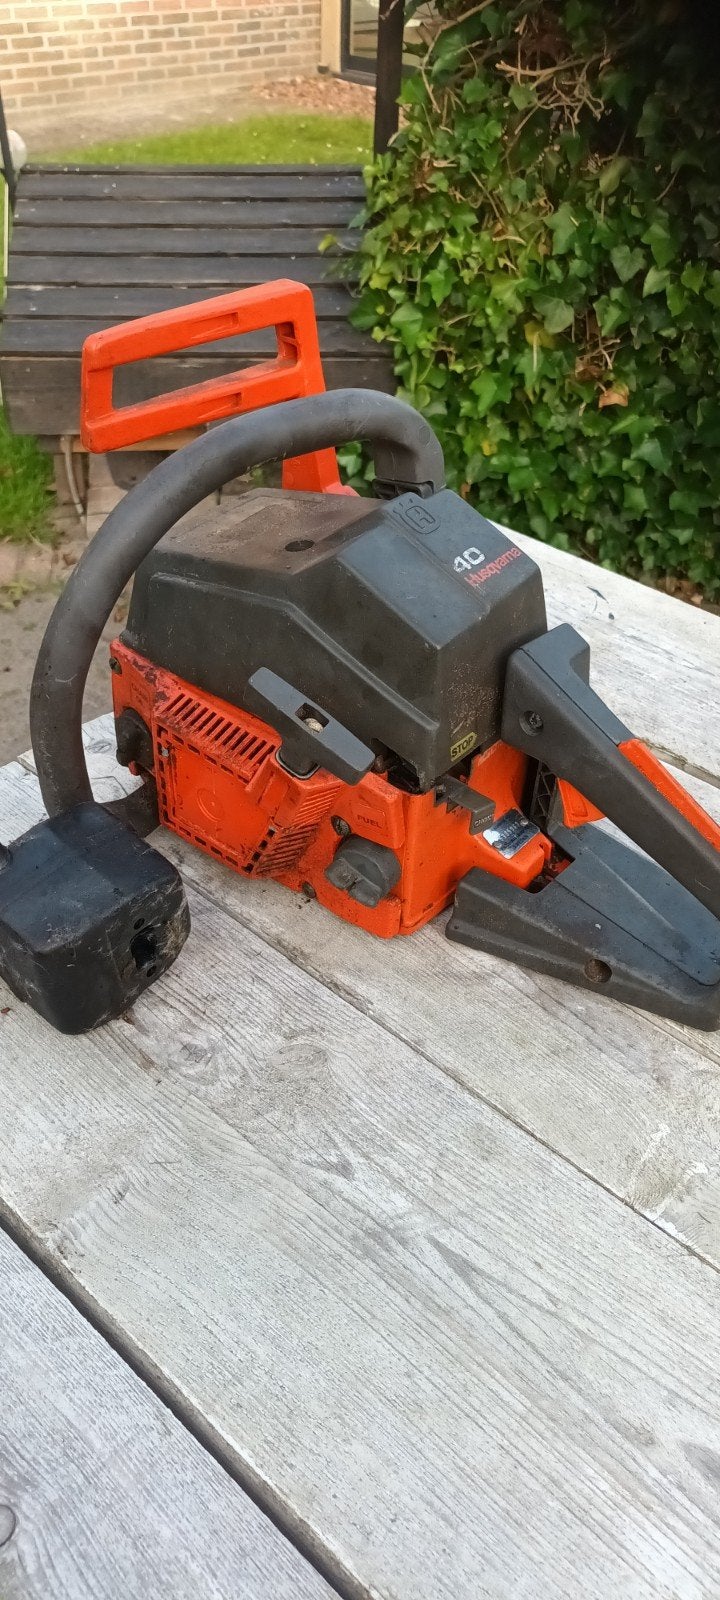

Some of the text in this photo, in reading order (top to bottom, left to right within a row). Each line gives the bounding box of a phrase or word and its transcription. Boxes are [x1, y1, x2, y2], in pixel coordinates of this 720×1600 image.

[454, 547, 485, 573] 40
[464, 548, 521, 588] Husqvarna
[451, 735, 474, 758] STOP
[357, 815, 383, 829] FUEL
